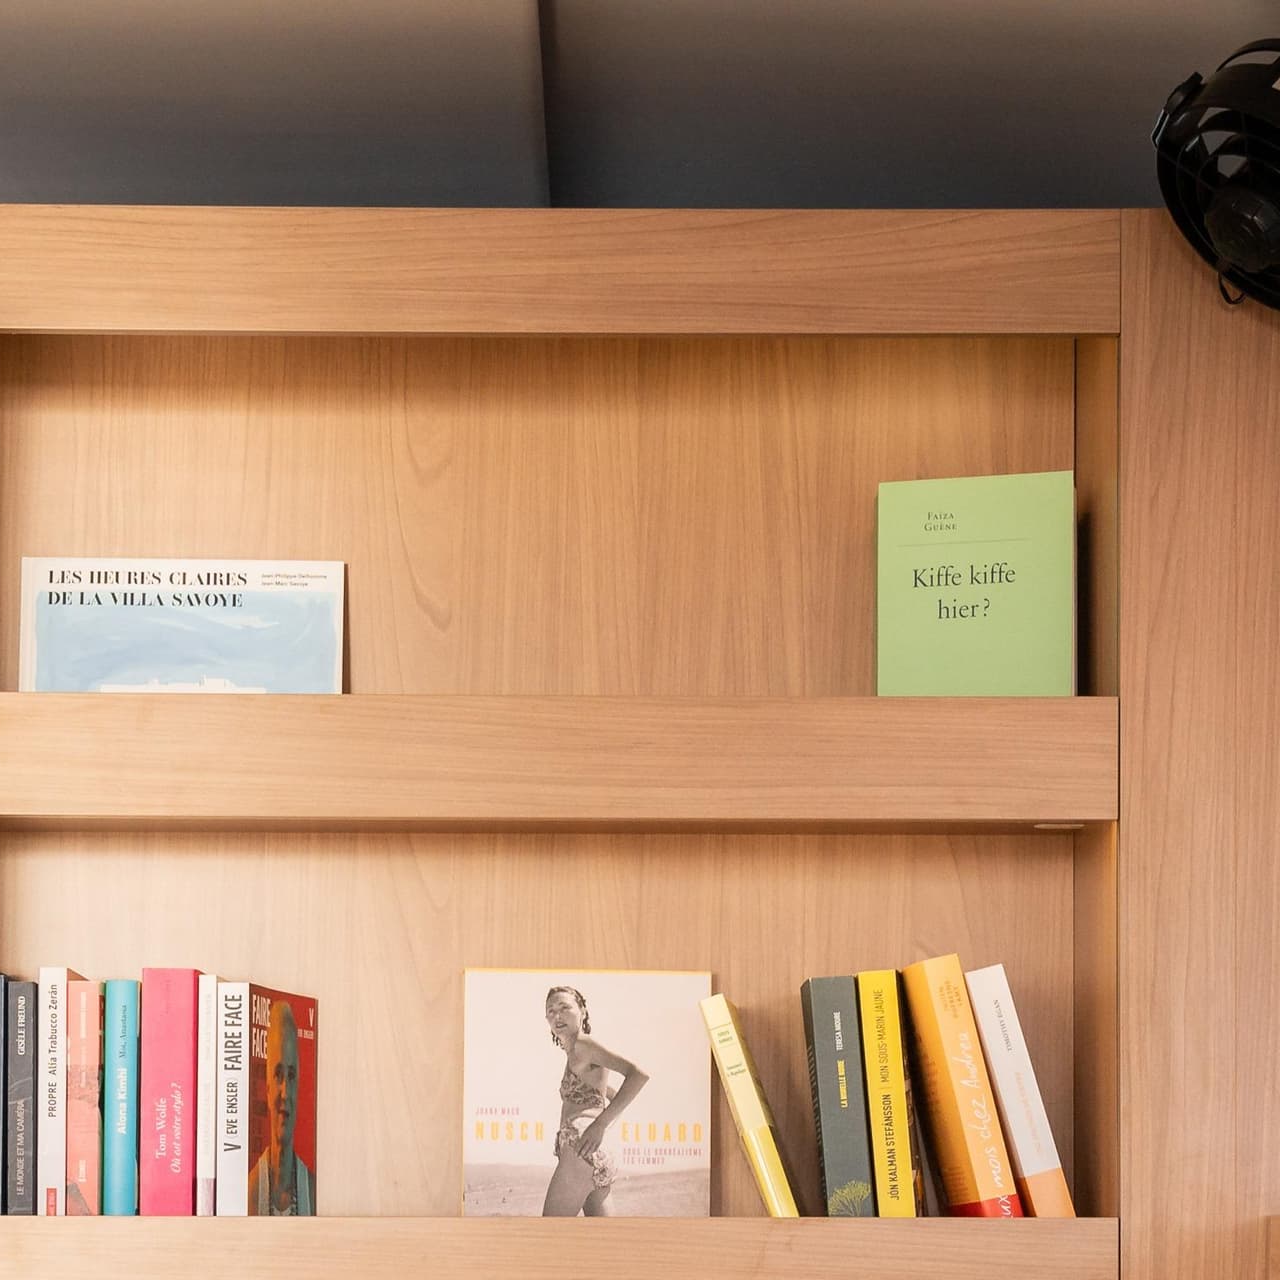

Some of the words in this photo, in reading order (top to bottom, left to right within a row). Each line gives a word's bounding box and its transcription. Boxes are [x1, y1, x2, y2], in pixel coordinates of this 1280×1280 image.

[48, 570, 82, 584] LES
[89, 571, 162, 585] HEURES
[169, 572, 248, 587] CLAIRES
[912, 565, 963, 589] Kiffe
[969, 562, 1017, 586] kiffe
[48, 592, 73, 606] DE
[79, 592, 103, 606] LA
[110, 592, 165, 607] VILLA
[172, 592, 243, 608] SAVOYE
[937, 599, 980, 620] hier
[223, 994, 242, 1028] FACE
[252, 994, 271, 1028] FAIRE
[873, 989, 884, 1014] JAUNE
[48, 1012, 58, 1052] Trabucco
[308, 1007, 315, 1028] V
[223, 1031, 242, 1072] FAIRE
[252, 1027, 268, 1060] FACE
[876, 1015, 888, 1064] SOUS-MARIN
[117, 1067, 128, 1099] Kimhi
[881, 1065, 889, 1083] MON
[47, 1081, 58, 1118] PROPRE
[226, 1081, 238, 1110] ENSLER
[155, 1096, 167, 1130] Wolfe
[882, 1093, 895, 1147] STEFÁNSSON
[967, 1096, 992, 1140] chez
[155, 1131, 167, 1160] Tom
[474, 1121, 545, 1142] NUSCH
[223, 1142, 242, 1153] V
[888, 1147, 898, 1184] KALMAN
[890, 1180, 899, 1200] JÓN
